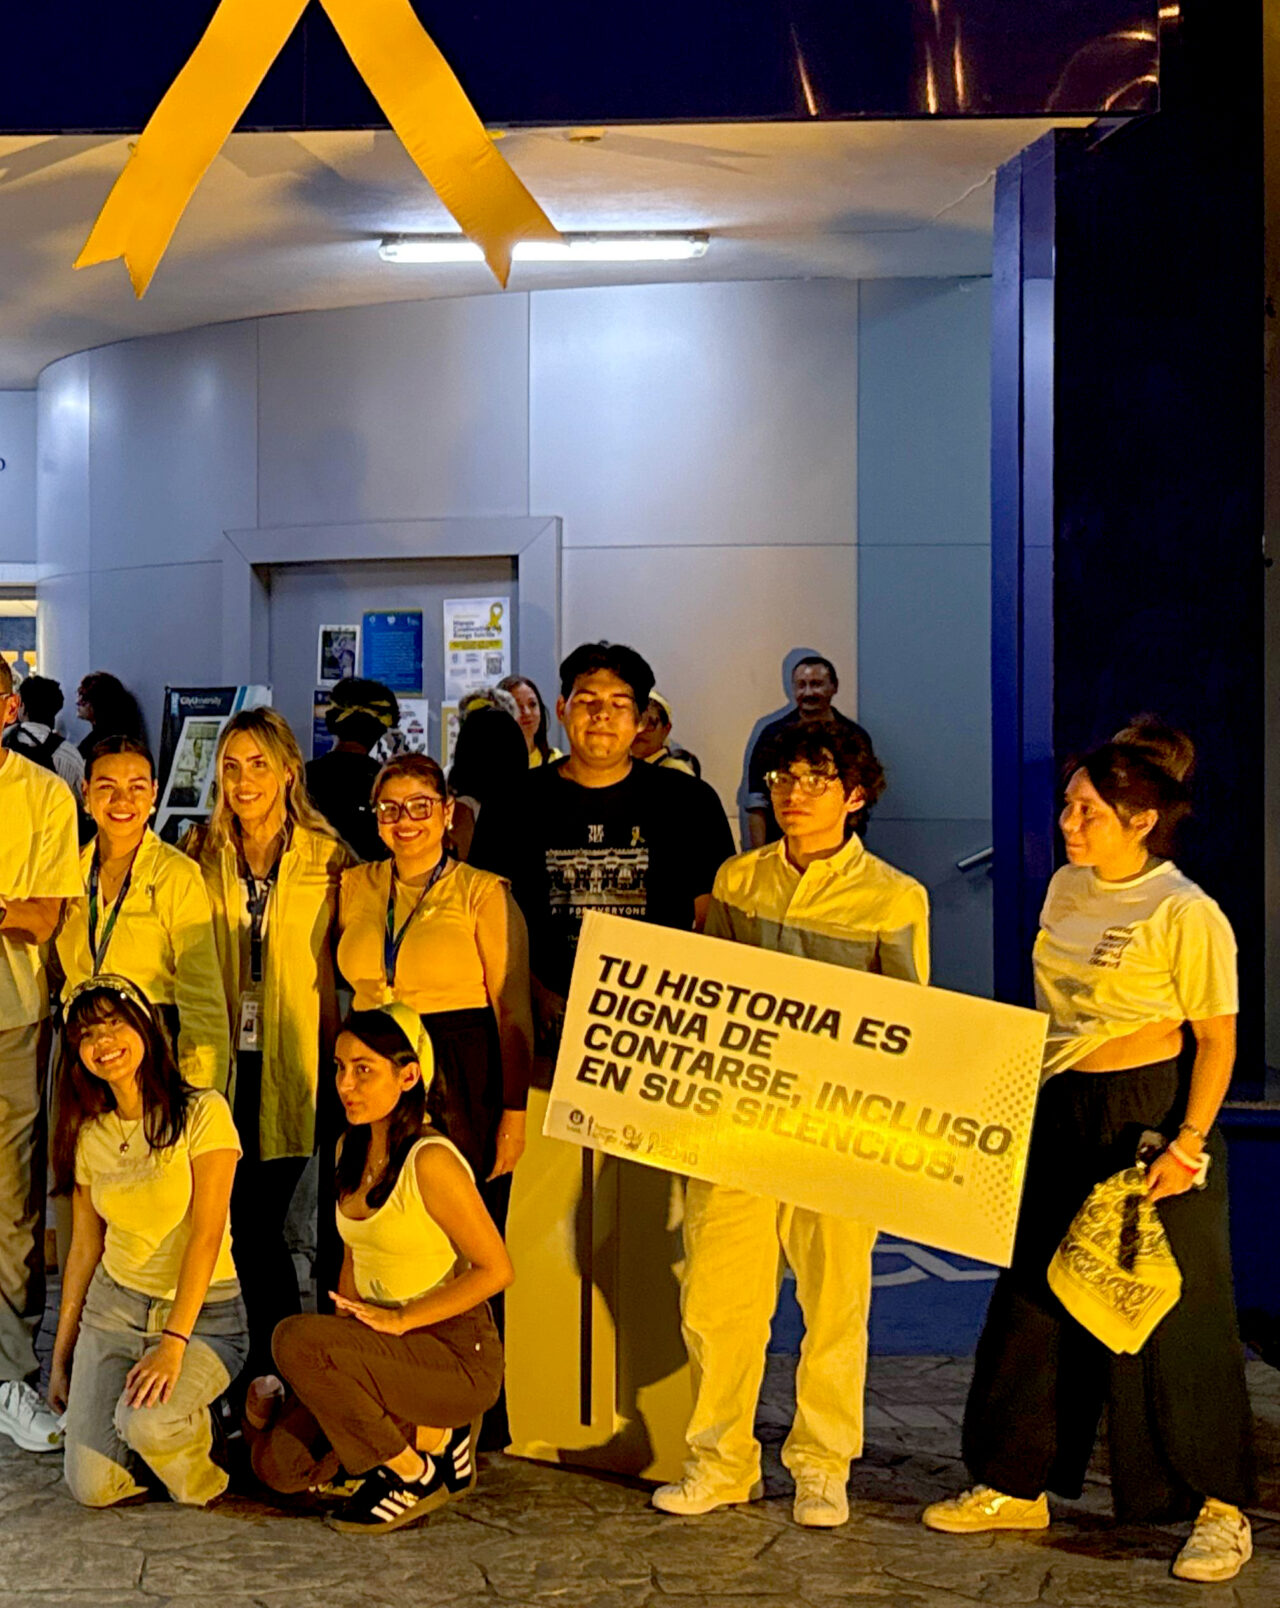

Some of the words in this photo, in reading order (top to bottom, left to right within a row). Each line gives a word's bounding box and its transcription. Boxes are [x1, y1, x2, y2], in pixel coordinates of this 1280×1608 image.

[588, 989, 708, 1044] DIGNA
[719, 1022, 780, 1059] DE
[597, 955, 649, 991] TU
[655, 970, 841, 1039] HISTORIA
[853, 1017, 912, 1055] ES
[576, 1058, 632, 1093] EN
[639, 1073, 722, 1118] SUS
[732, 1099, 964, 1185] SILENCIOS.
[583, 1023, 801, 1109] CONTARSE,
[815, 1081, 1012, 1156] INCLUSO
